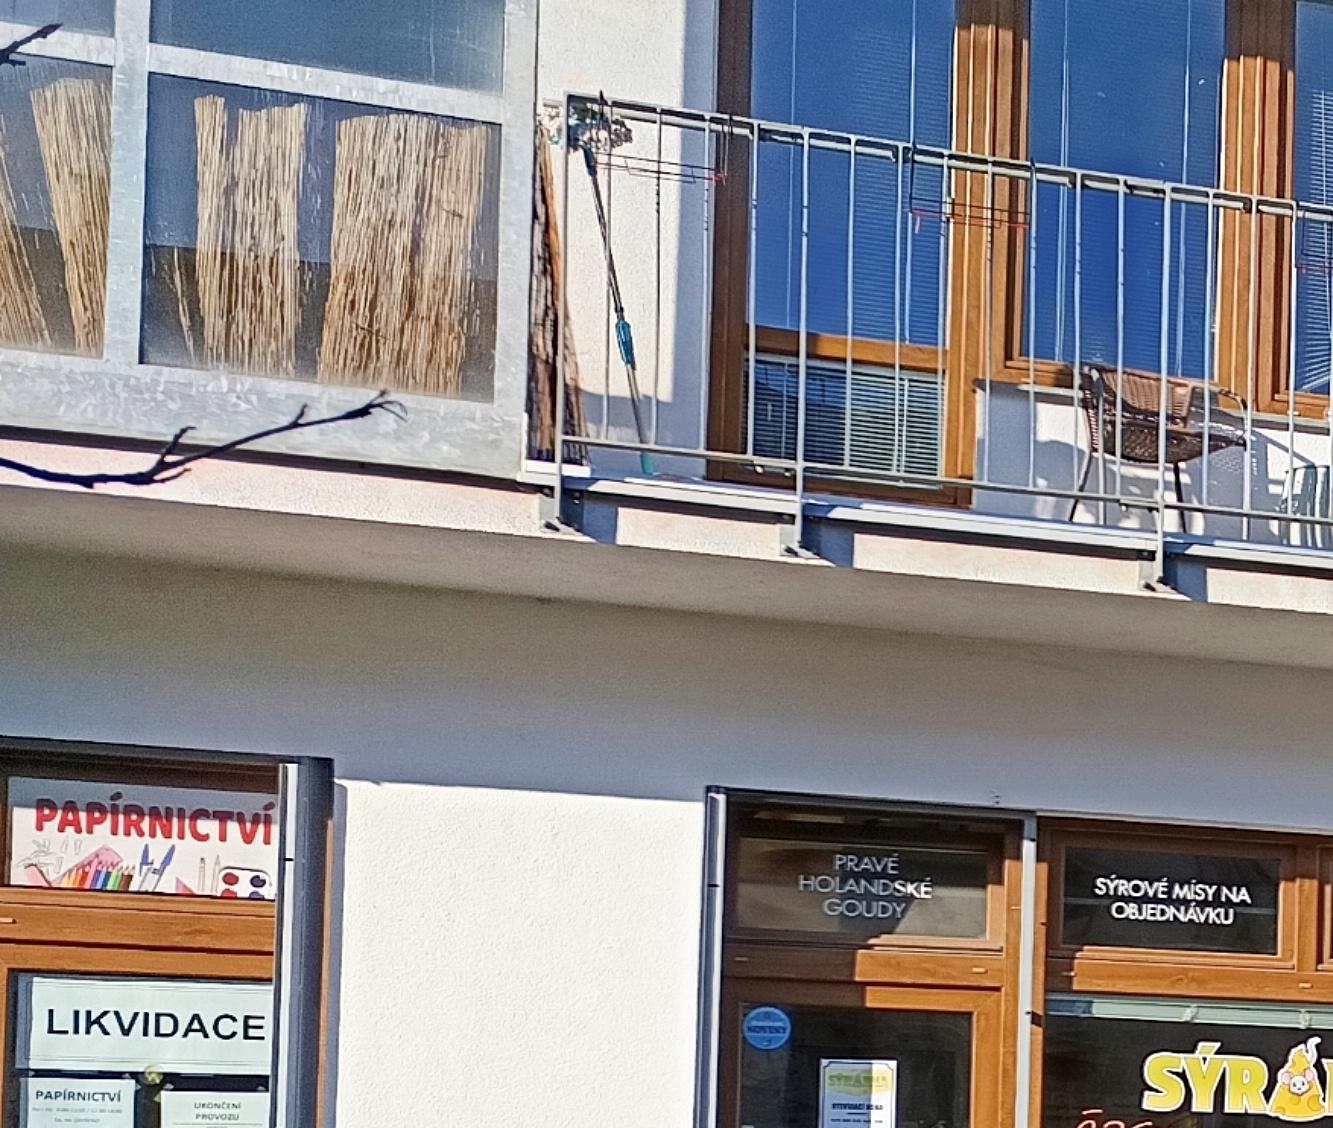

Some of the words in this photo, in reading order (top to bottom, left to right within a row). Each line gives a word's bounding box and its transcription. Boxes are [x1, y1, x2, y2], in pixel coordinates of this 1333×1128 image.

[34, 791, 275, 845] PAPÍRNICTVÍ
[833, 853, 900, 875] PRAVÉ
[798, 876, 934, 899] HOLANDSKÉ
[1094, 874, 1169, 899] SÝROVÉ
[1172, 879, 1217, 902] MÍSY
[1221, 884, 1252, 904] NA
[823, 897, 906, 918] GOUDY
[1110, 901, 1235, 925] OBJEDNÁVKU
[47, 1008, 266, 1041] LIKVIDACE
[35, 1088, 122, 1103] PAPÍRNICTVÍ
